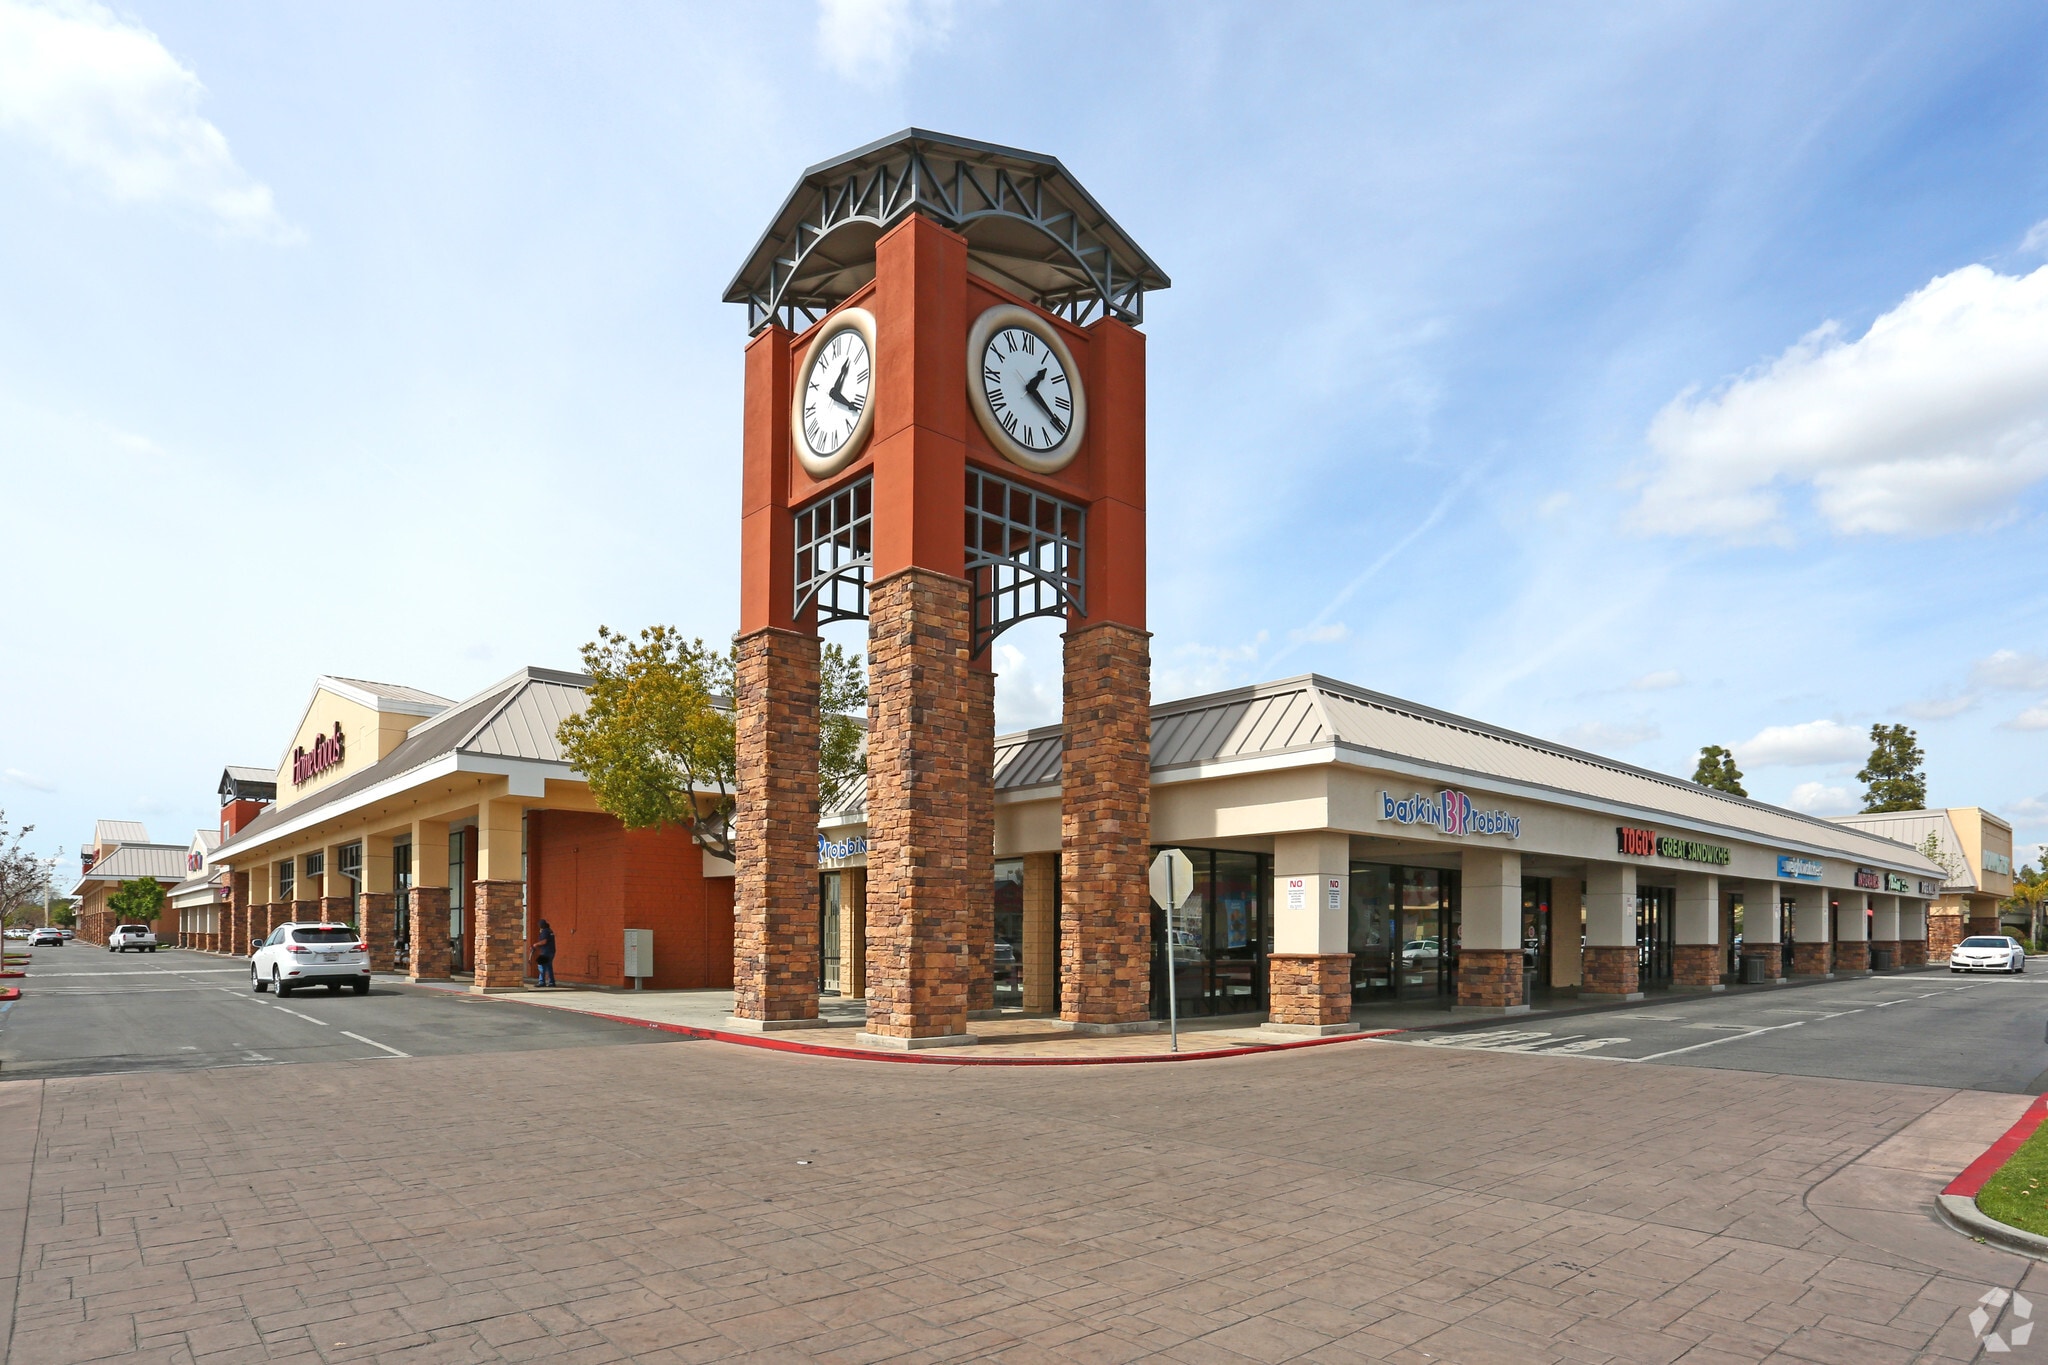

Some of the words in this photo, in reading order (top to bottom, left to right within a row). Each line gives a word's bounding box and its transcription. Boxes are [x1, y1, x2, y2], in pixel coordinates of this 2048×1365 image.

[990, 342, 1005, 363] X
[1022, 331, 1034, 356] XII
[292, 721, 345, 786] HomeGoods
[825, 836, 868, 860] robbin
[1620, 827, 1656, 856] TOGO'S
[1659, 837, 1687, 859] GREAT
[1688, 841, 1731, 865] SANDWICHES
[1290, 880, 1303, 888] NO
[1329, 880, 1339, 888] NO
